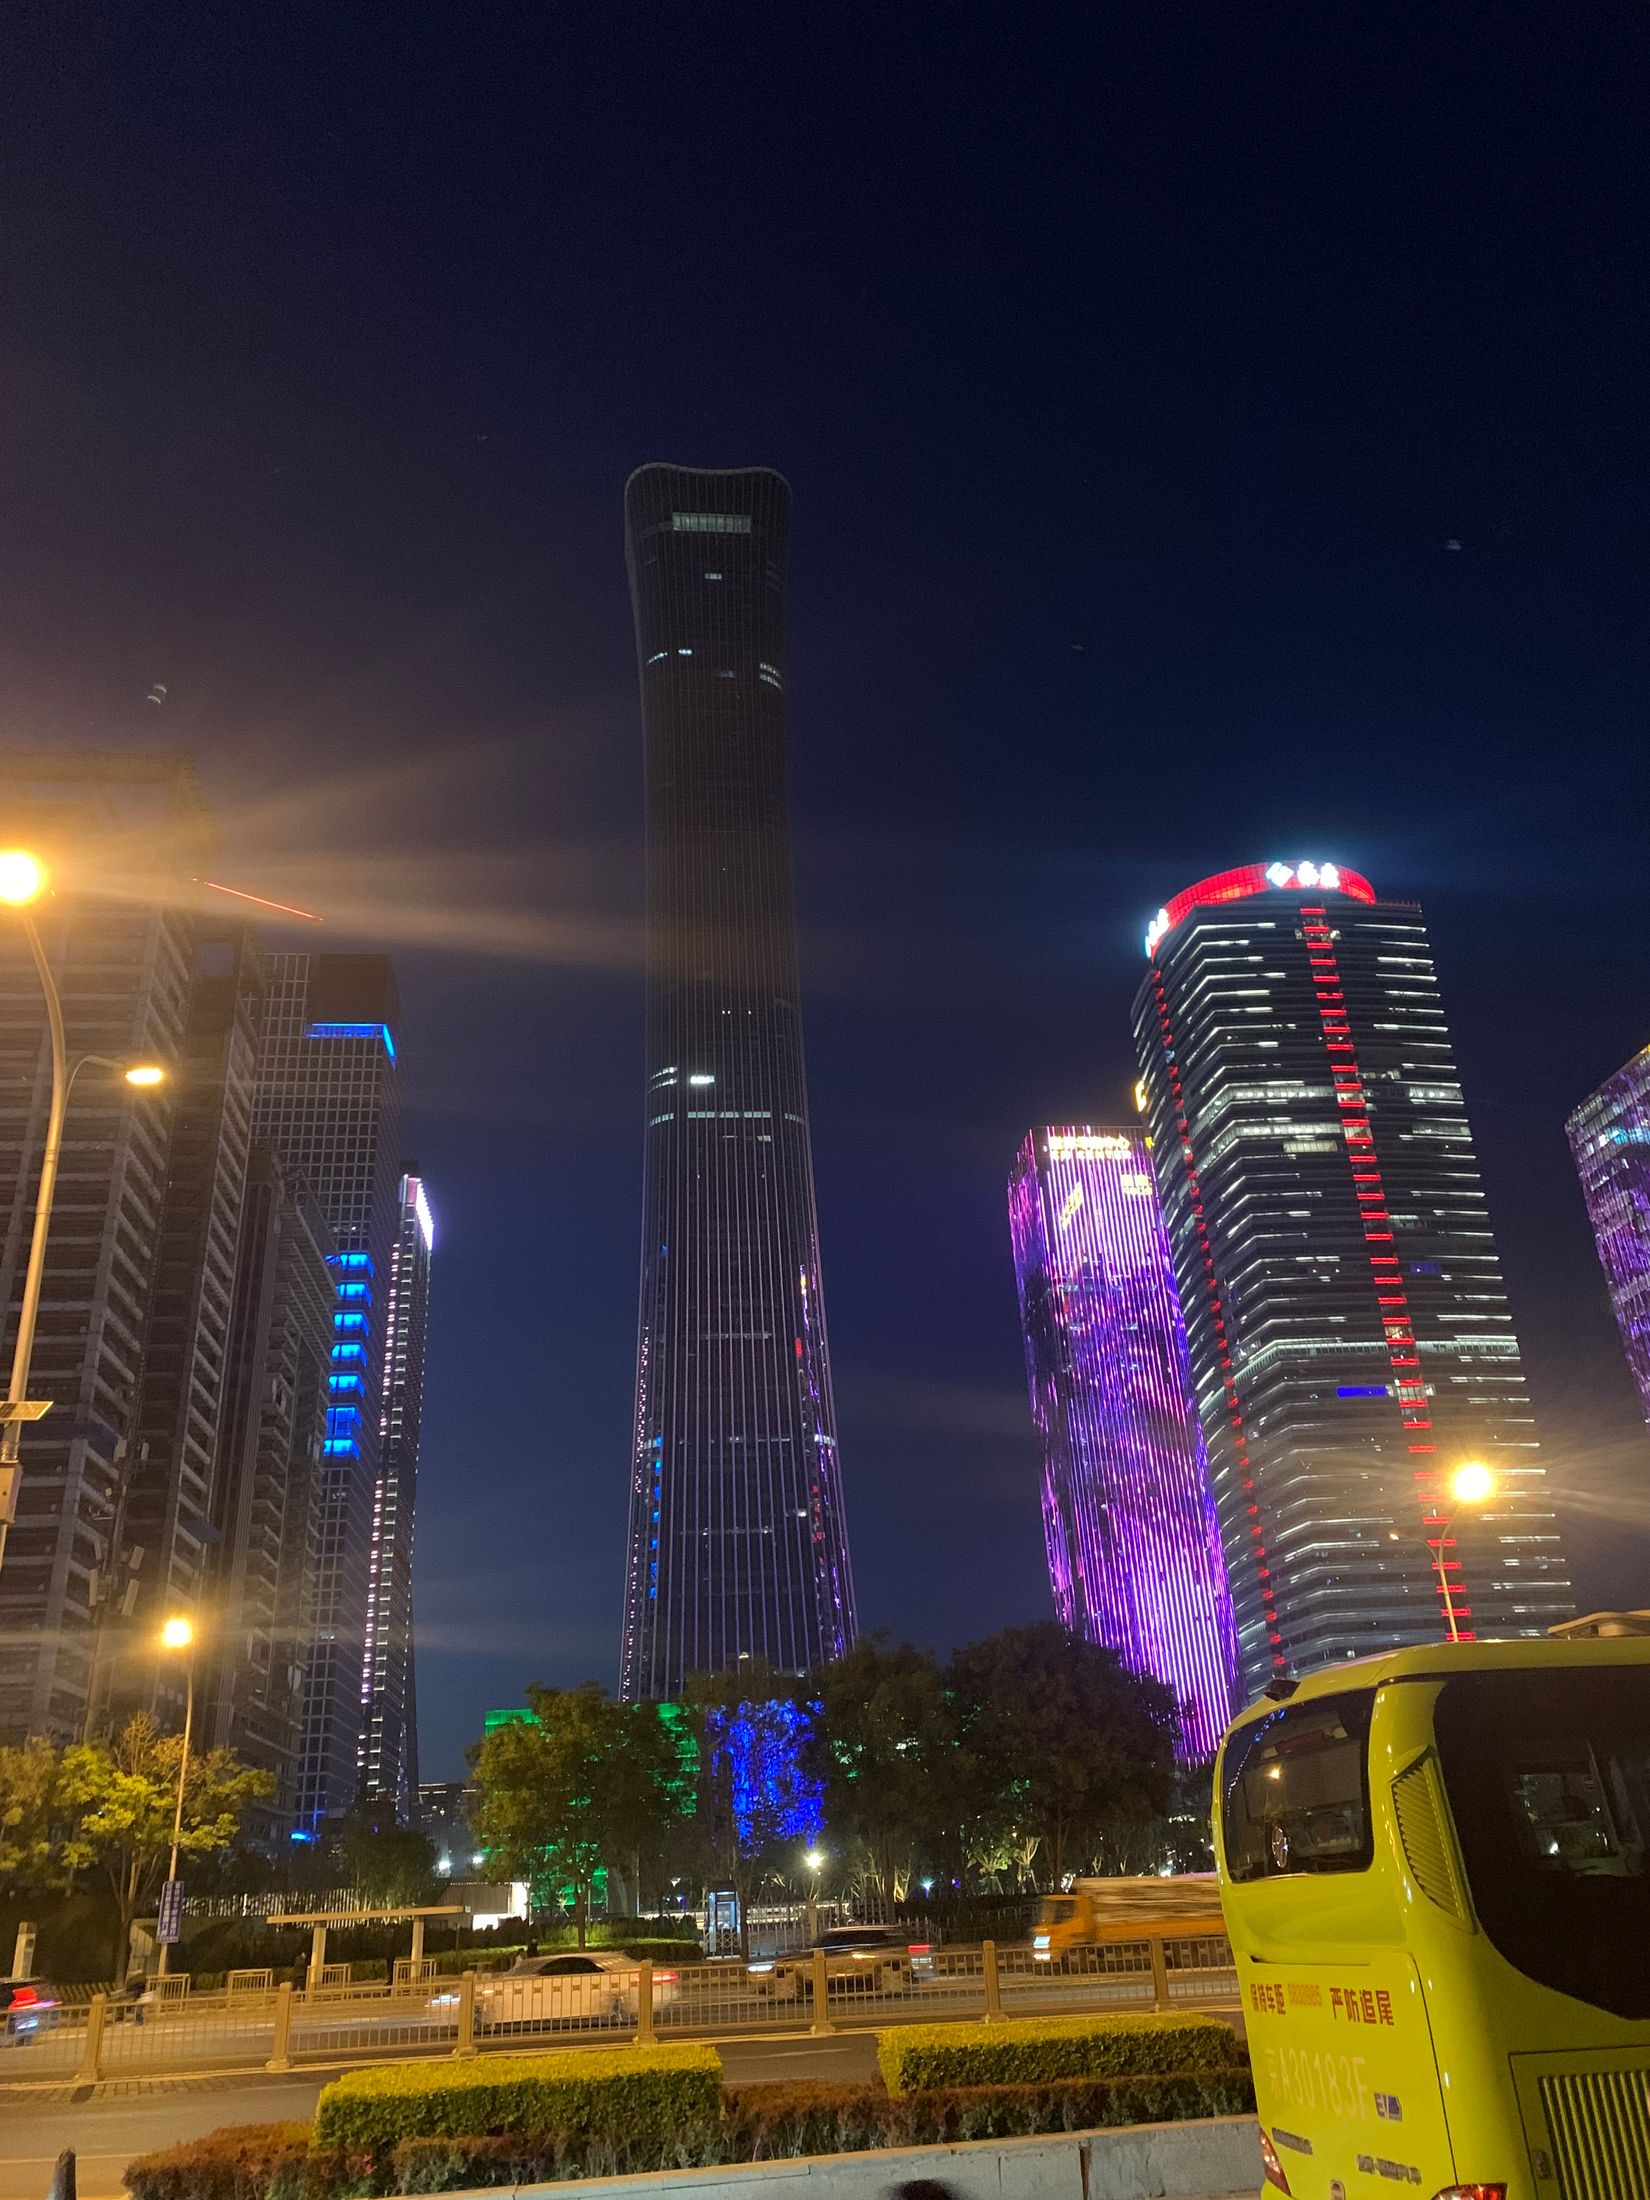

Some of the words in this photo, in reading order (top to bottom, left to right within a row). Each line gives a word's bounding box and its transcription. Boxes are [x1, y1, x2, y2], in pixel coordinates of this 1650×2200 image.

[1250, 1983, 1286, 2015] 保持车距
[1329, 1987, 1394, 2026] 严防追尾
